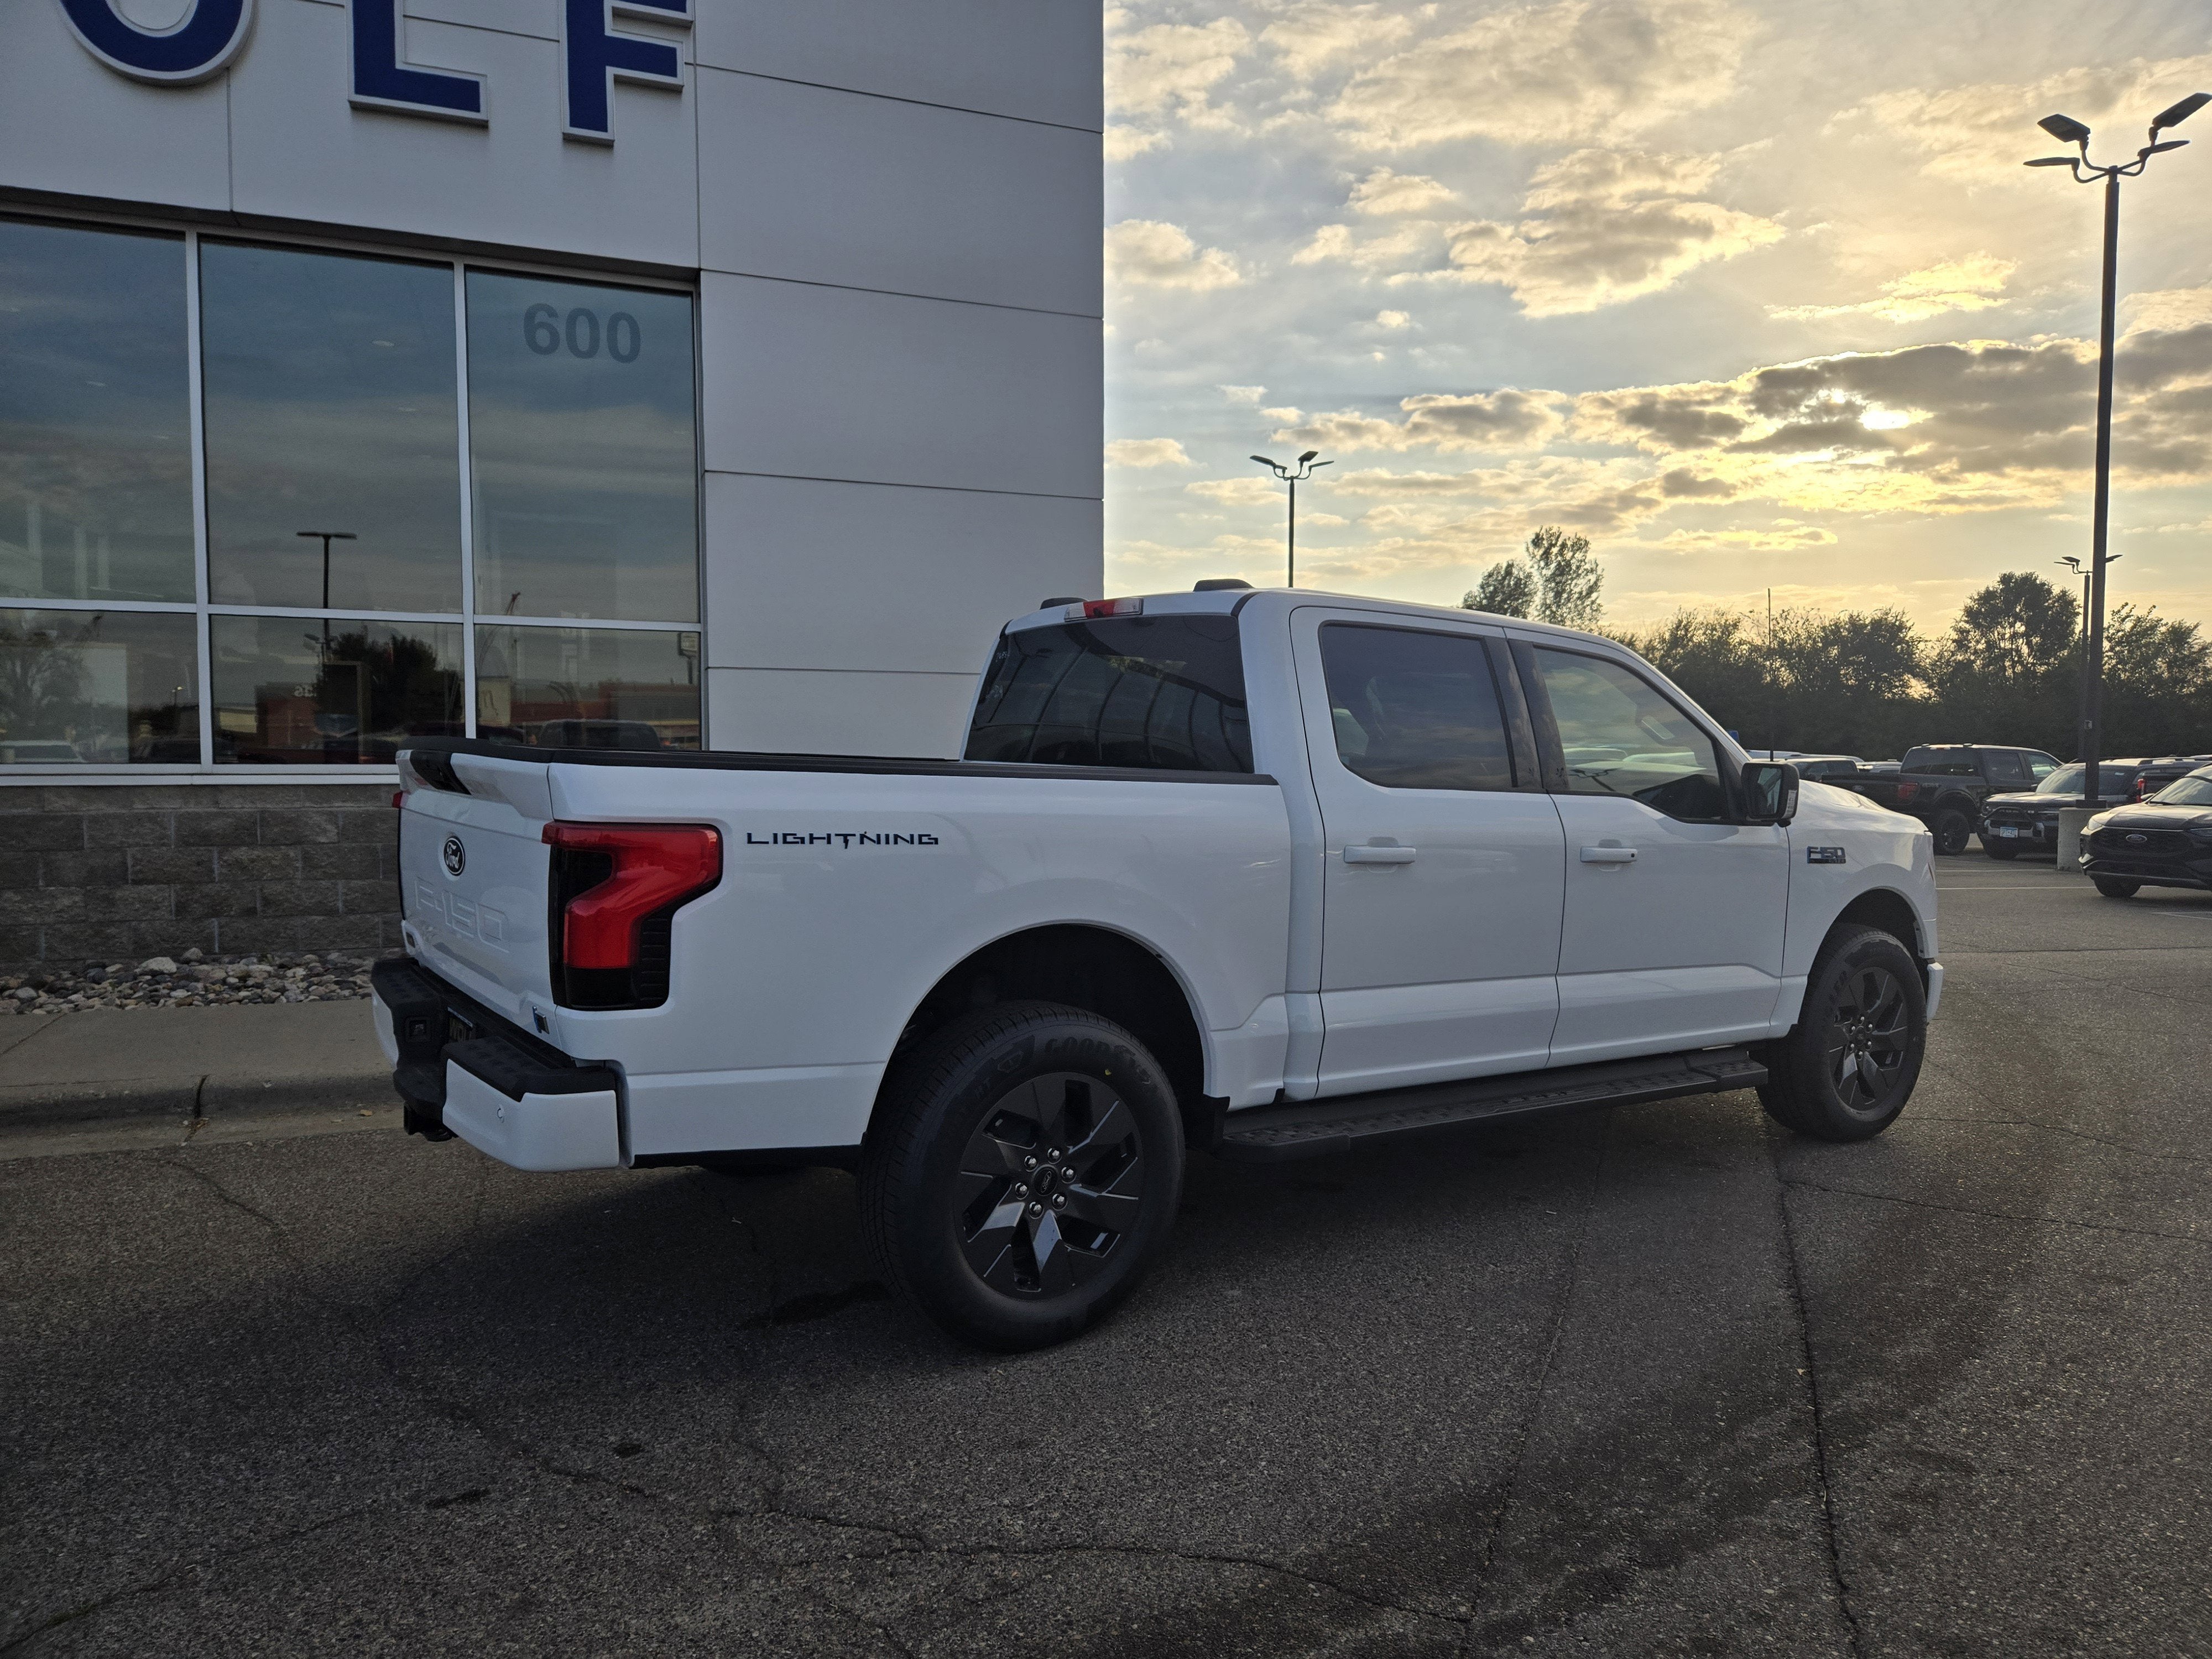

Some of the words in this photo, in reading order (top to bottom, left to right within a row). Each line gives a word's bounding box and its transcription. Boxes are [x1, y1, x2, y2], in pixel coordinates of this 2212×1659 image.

[524, 303, 641, 363] 600
[747, 832, 939, 849] LIGHTNING
[445, 842, 461, 870] Ford
